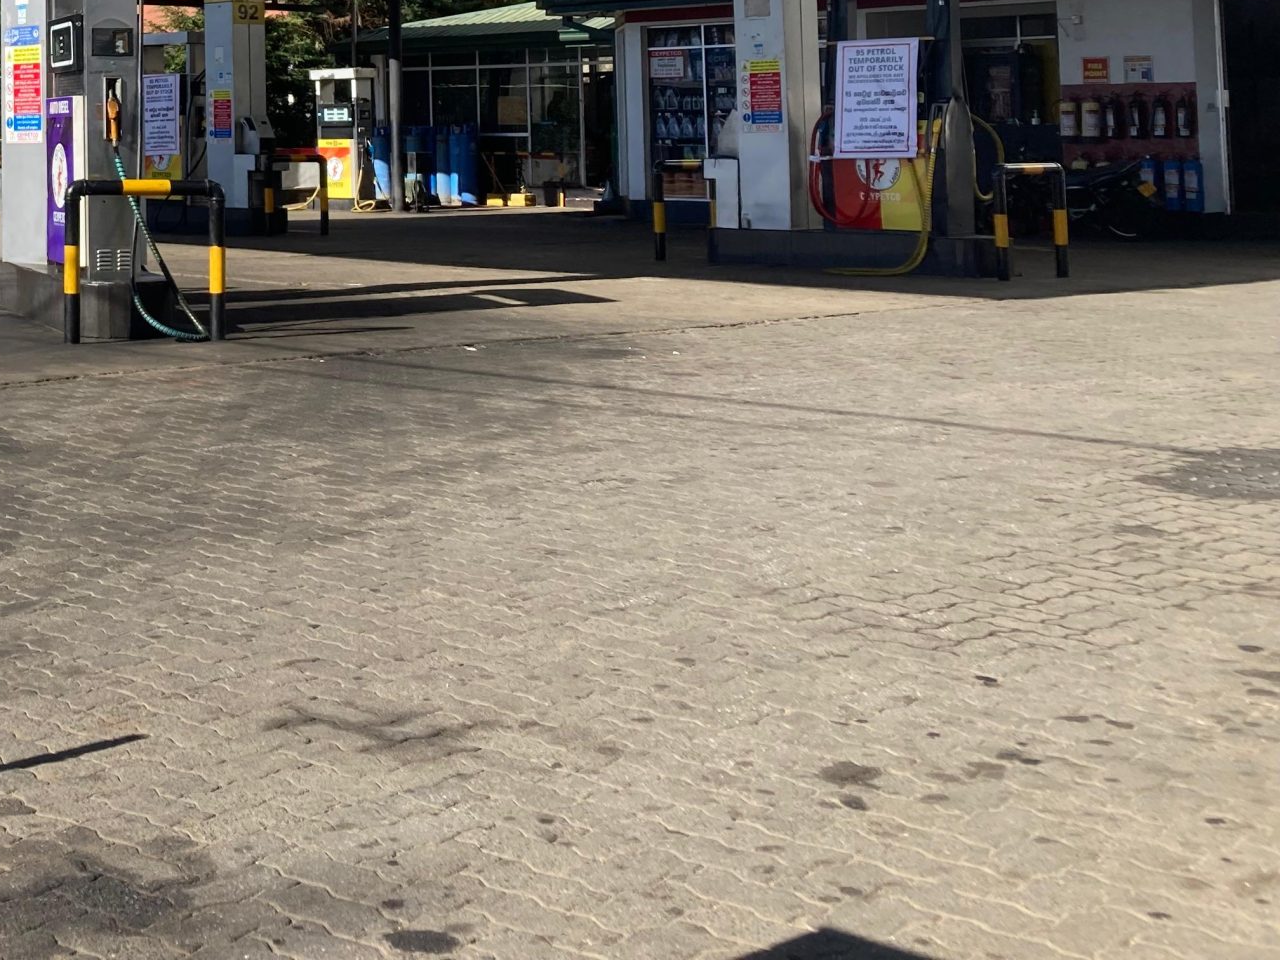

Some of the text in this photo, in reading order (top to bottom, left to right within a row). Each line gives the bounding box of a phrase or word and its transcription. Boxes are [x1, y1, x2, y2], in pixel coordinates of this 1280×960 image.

[238, 5, 260, 20] 92
[866, 48, 897, 56] PETROL
[848, 56, 904, 65] TEMPORARILY
[848, 65, 865, 73] OUT
[878, 64, 905, 72] STOCK
[860, 191, 901, 201] CYPETCO
